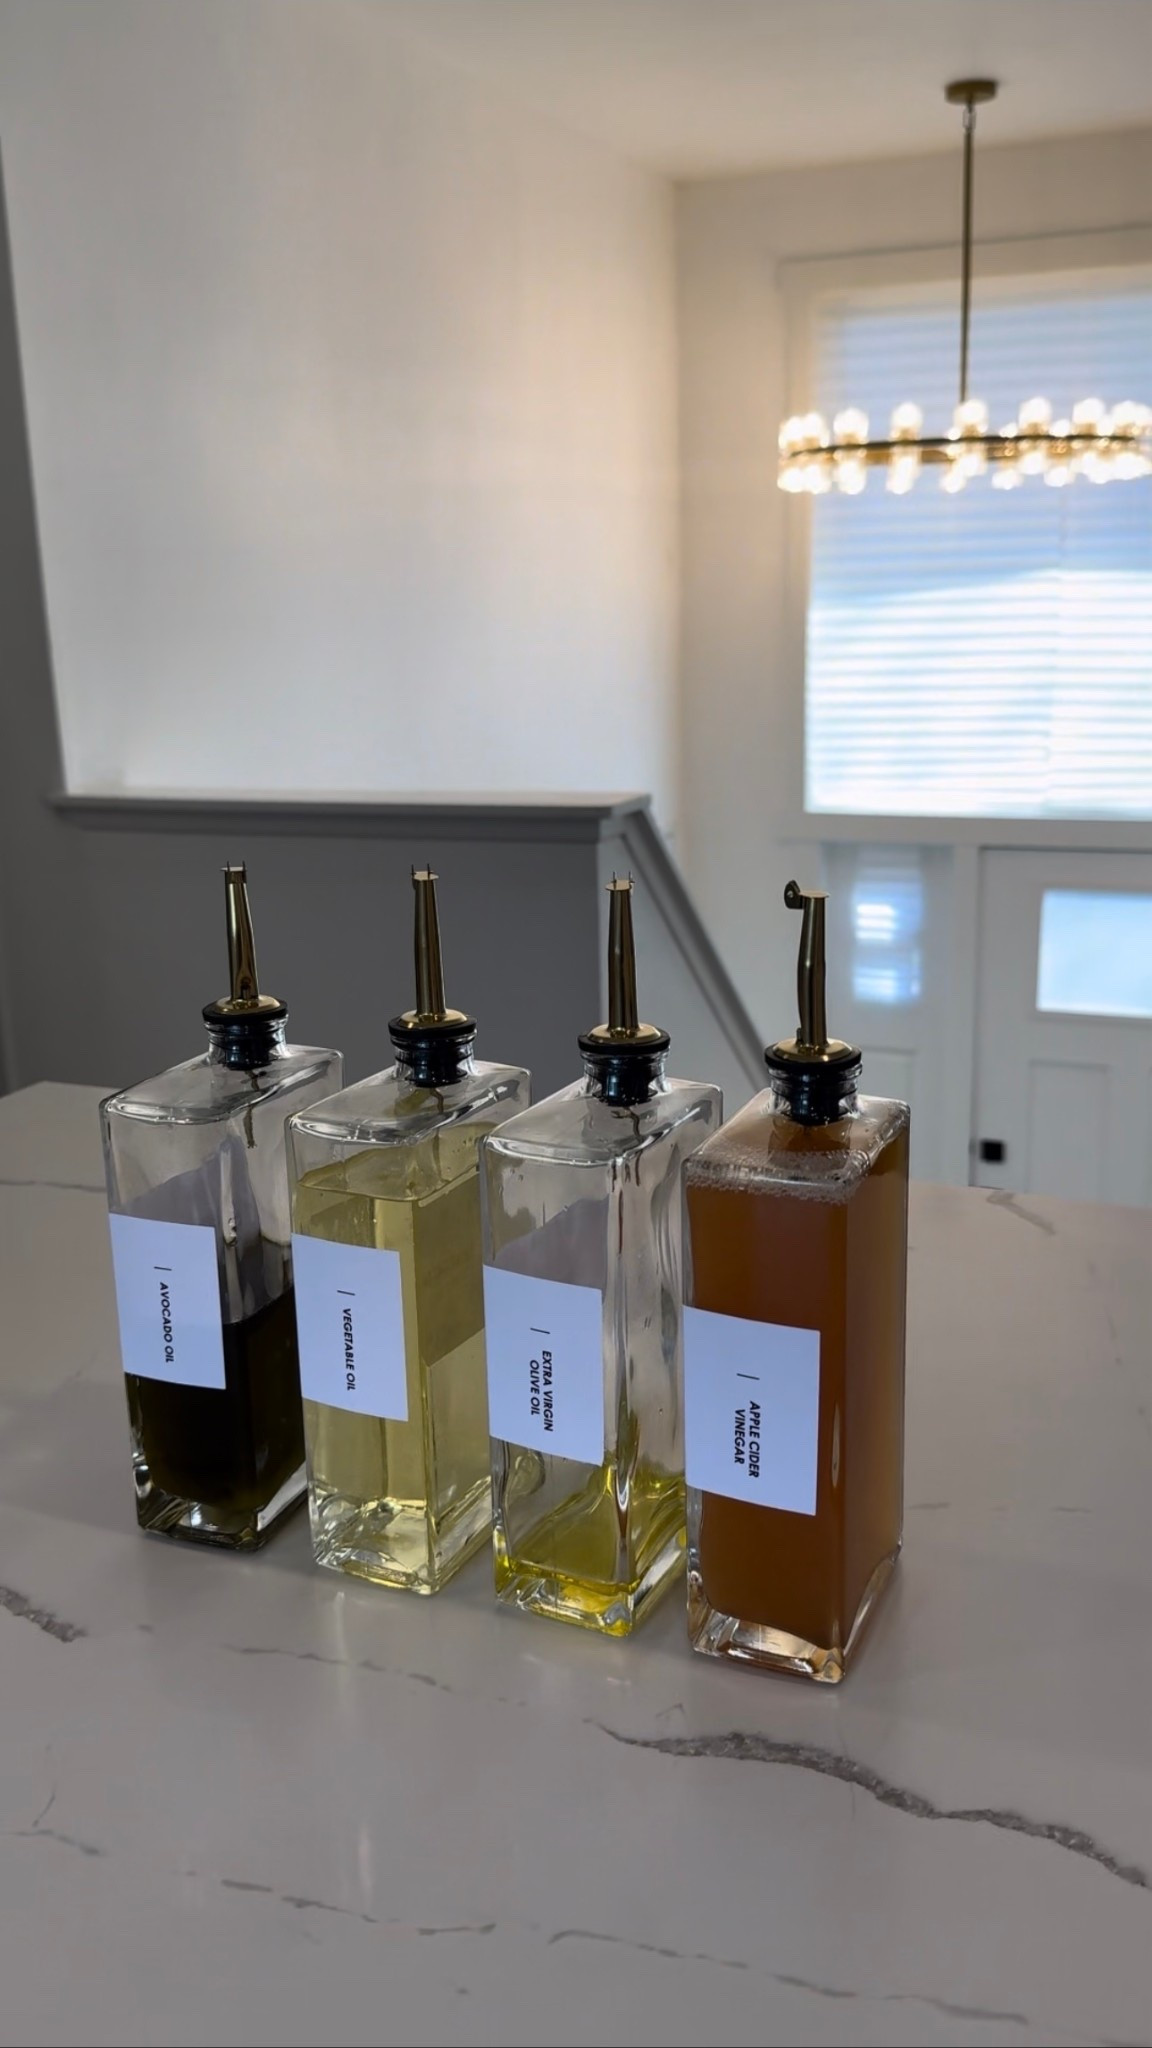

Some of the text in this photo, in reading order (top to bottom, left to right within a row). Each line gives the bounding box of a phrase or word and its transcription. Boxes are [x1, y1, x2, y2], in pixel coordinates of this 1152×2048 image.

[159, 1281, 175, 1363] AVOCADO OIL
[342, 1308, 356, 1391] VEGETABLE OIL
[529, 1359, 541, 1417] OLIVE OIL
[541, 1350, 554, 1432] EXTRA VIRGIN
[734, 1408, 747, 1465] VINEGAR
[748, 1400, 761, 1479] APPLE CIDER
